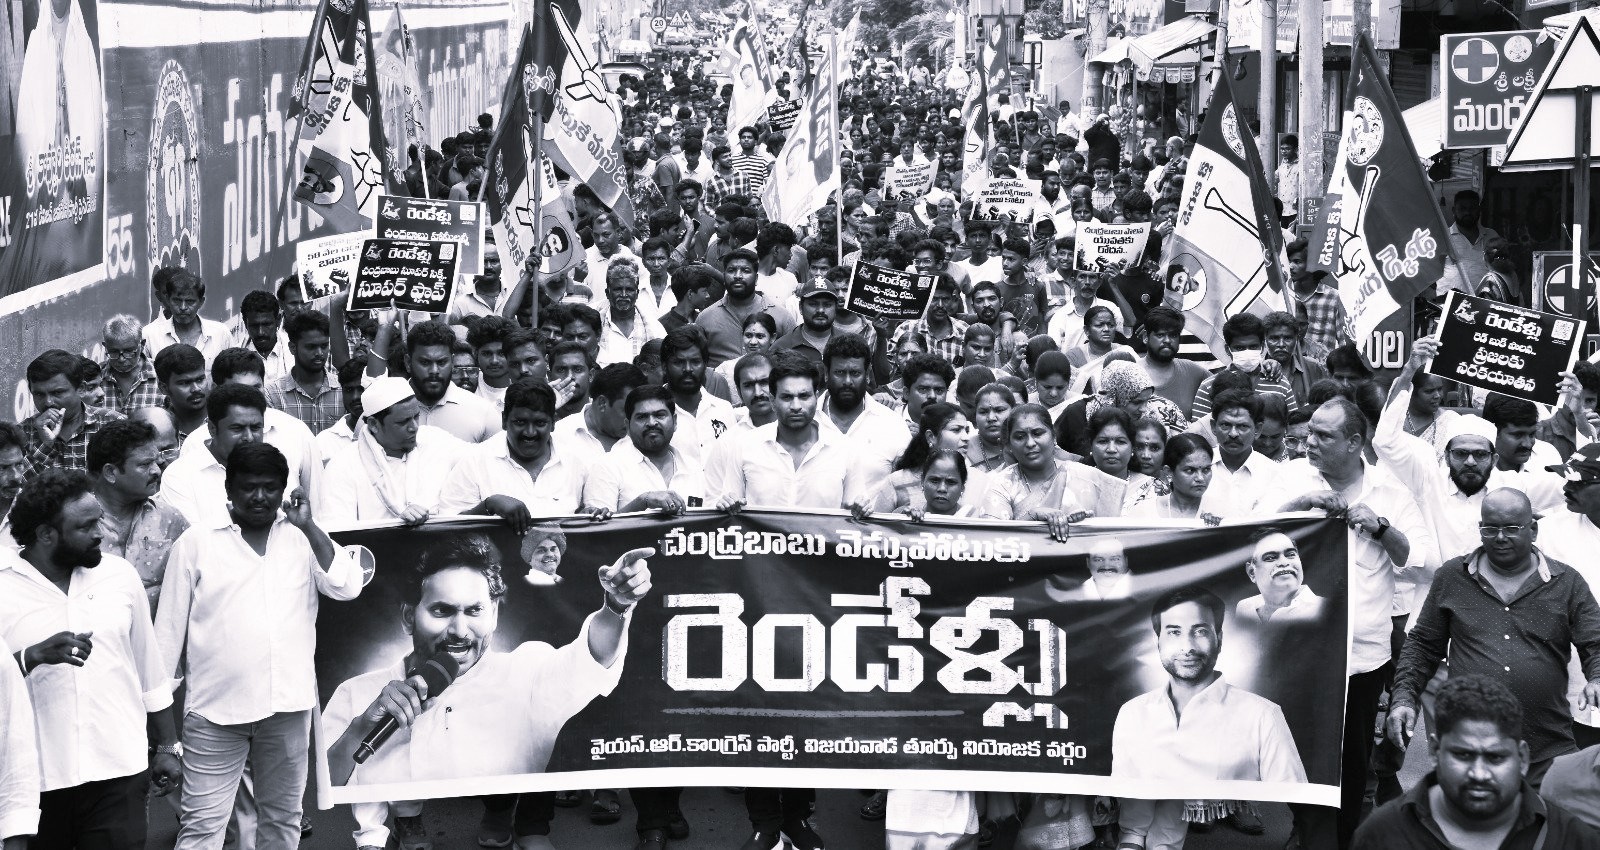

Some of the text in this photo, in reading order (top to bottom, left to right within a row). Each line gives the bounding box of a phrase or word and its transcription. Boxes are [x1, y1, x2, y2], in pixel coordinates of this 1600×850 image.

[1494, 71, 1509, 92] శ్రీ
[588, 134, 619, 174] మన
[406, 206, 452, 226] రెండేళ్లు
[1093, 236, 1134, 245] యువతకు
[1097, 244, 1128, 254] రోదన..
[388, 246, 433, 265] రెండేళ్లు
[361, 265, 400, 279] చంద్రబాబు
[400, 266, 430, 278] సూపర్
[357, 277, 446, 305] సూపర్ ఫ్లాప్
[1485, 311, 1543, 342] రెండేళ్లు
[1473, 331, 1489, 344] రెడ్
[1488, 336, 1508, 348] బుక్
[1472, 346, 1525, 370] ప్రజలకు
[1455, 361, 1537, 392] నరకయాతన
[662, 525, 1031, 568] చంద్రబాబు వెన్నుపోటుకు
[661, 575, 1069, 730] రెండేళ్లు
[590, 733, 1087, 766] వైయస్.ఆర్.కాంగ్రెస్ పార్టీ, విజయవాడ తూర్పు నియోజక వర్గం
